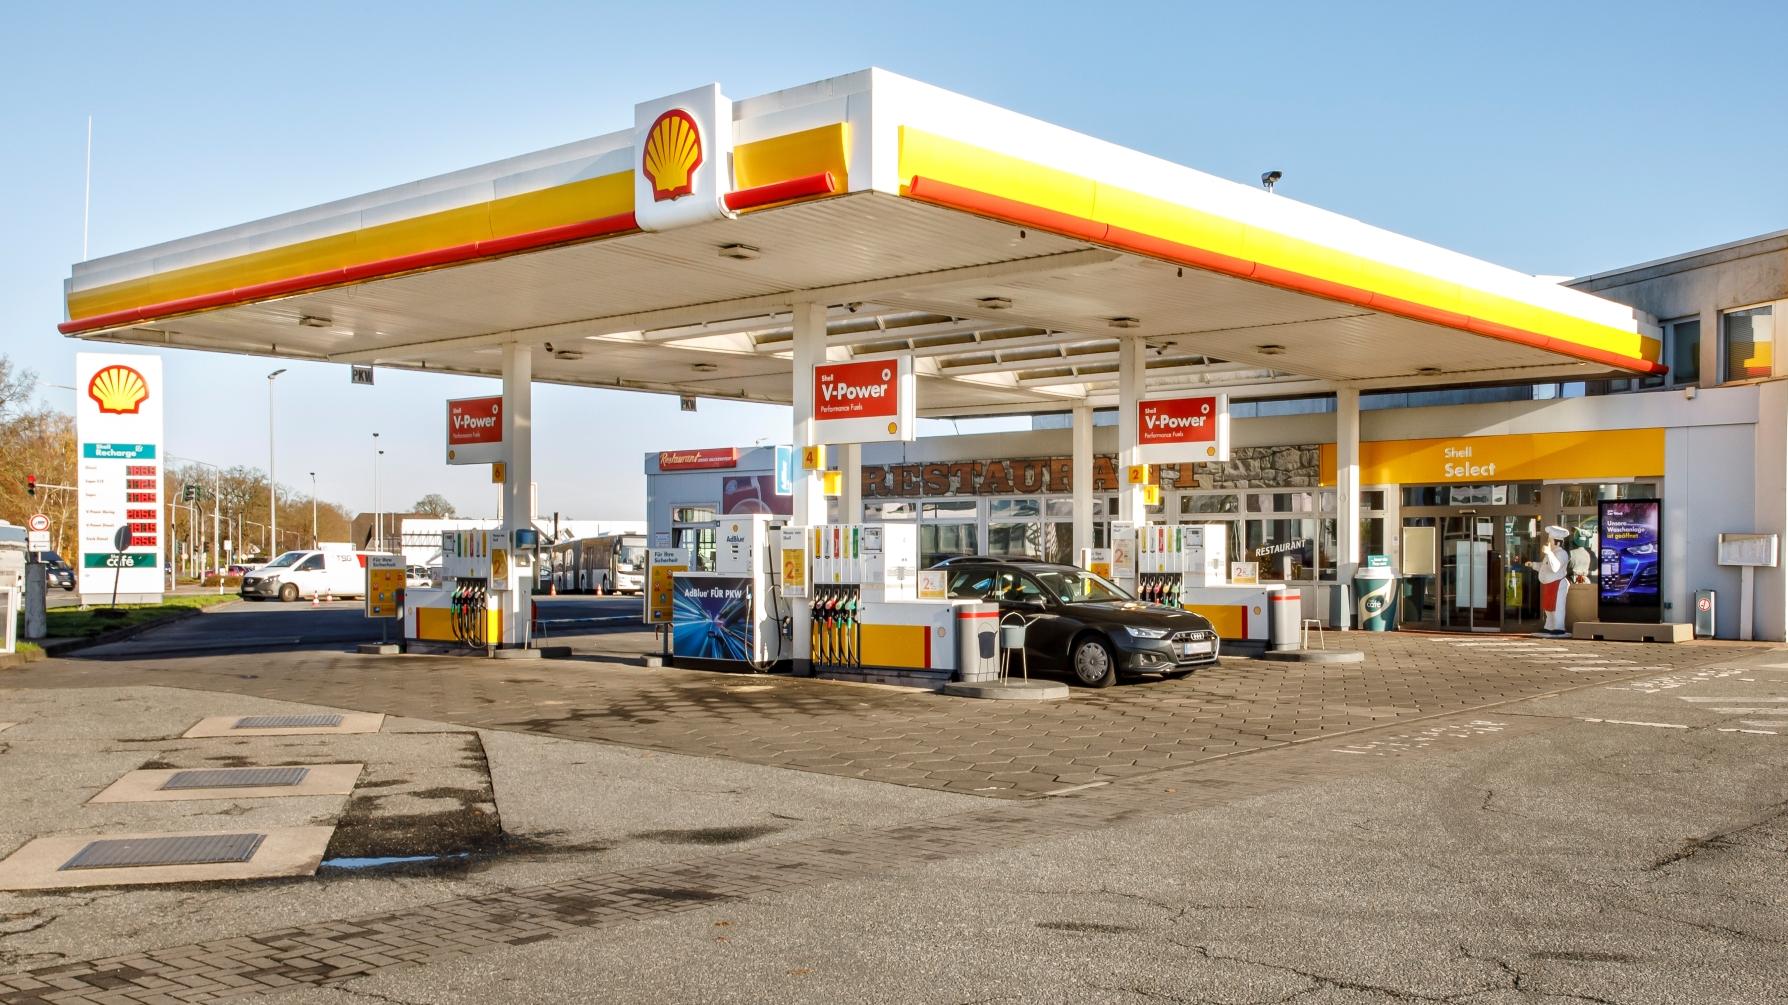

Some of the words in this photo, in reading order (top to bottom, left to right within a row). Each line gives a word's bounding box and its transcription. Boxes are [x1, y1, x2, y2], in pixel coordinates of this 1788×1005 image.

[352, 369, 373, 382] PKW
[822, 383, 888, 401] V-Power
[821, 405, 850, 413] Performance
[850, 403, 863, 411] Fuels
[454, 414, 496, 430] V-Power
[1145, 414, 1206, 429] V-Power
[96, 449, 137, 459] Recharge
[806, 452, 813, 464] 4
[1445, 446, 1472, 458] Shell
[661, 452, 702, 466] Restaurant
[494, 467, 501, 478] 6
[1132, 470, 1140, 480] 2
[1445, 461, 1496, 478] Select
[1256, 540, 1306, 557] RESTAURANT
[106, 555, 134, 567] café
[1115, 549, 1124, 563] 2
[785, 561, 794, 579] 2
[711, 587, 724, 598] FÜR
[725, 589, 742, 598] PKW
